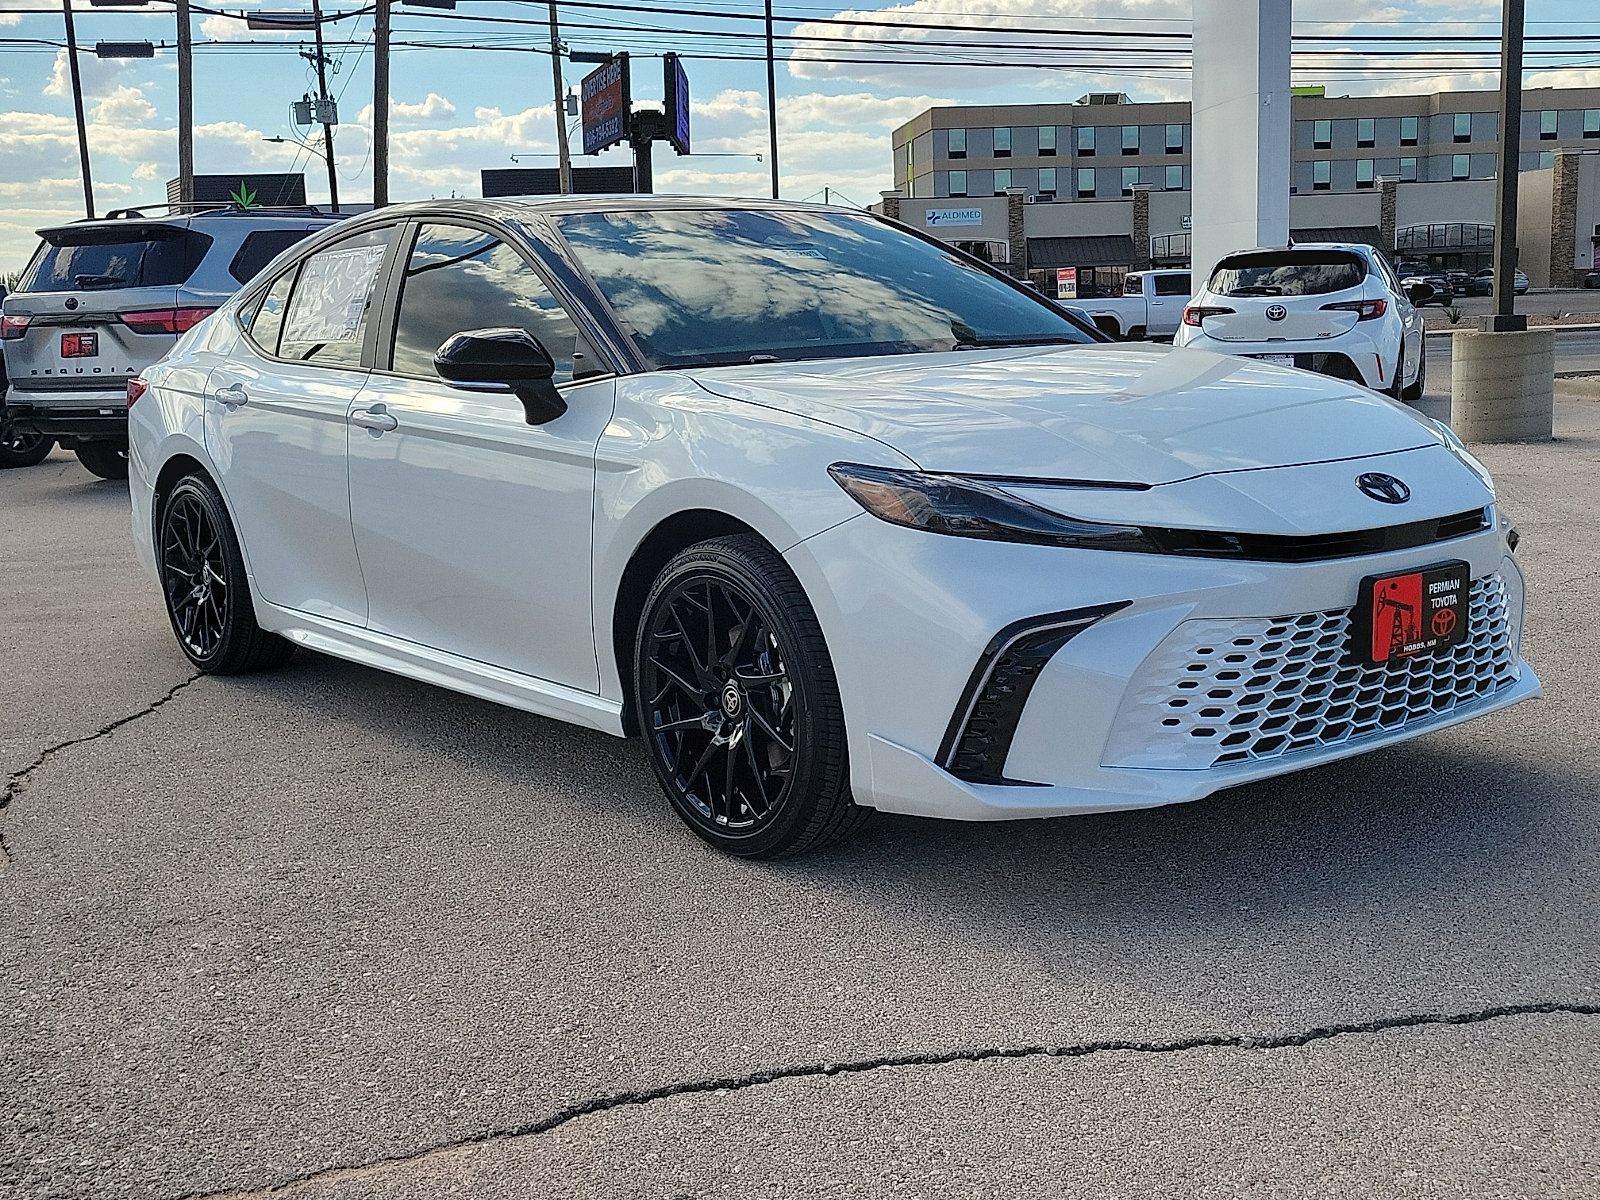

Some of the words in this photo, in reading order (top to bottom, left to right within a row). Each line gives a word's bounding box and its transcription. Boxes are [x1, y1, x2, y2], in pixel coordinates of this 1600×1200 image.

[942, 210, 981, 220] ALDIMED
[30, 366, 135, 376] SEQUOIA
[1428, 579, 1460, 594] PERMIAN
[1431, 594, 1458, 609] TOYOTA
[1426, 639, 1437, 648] NM
